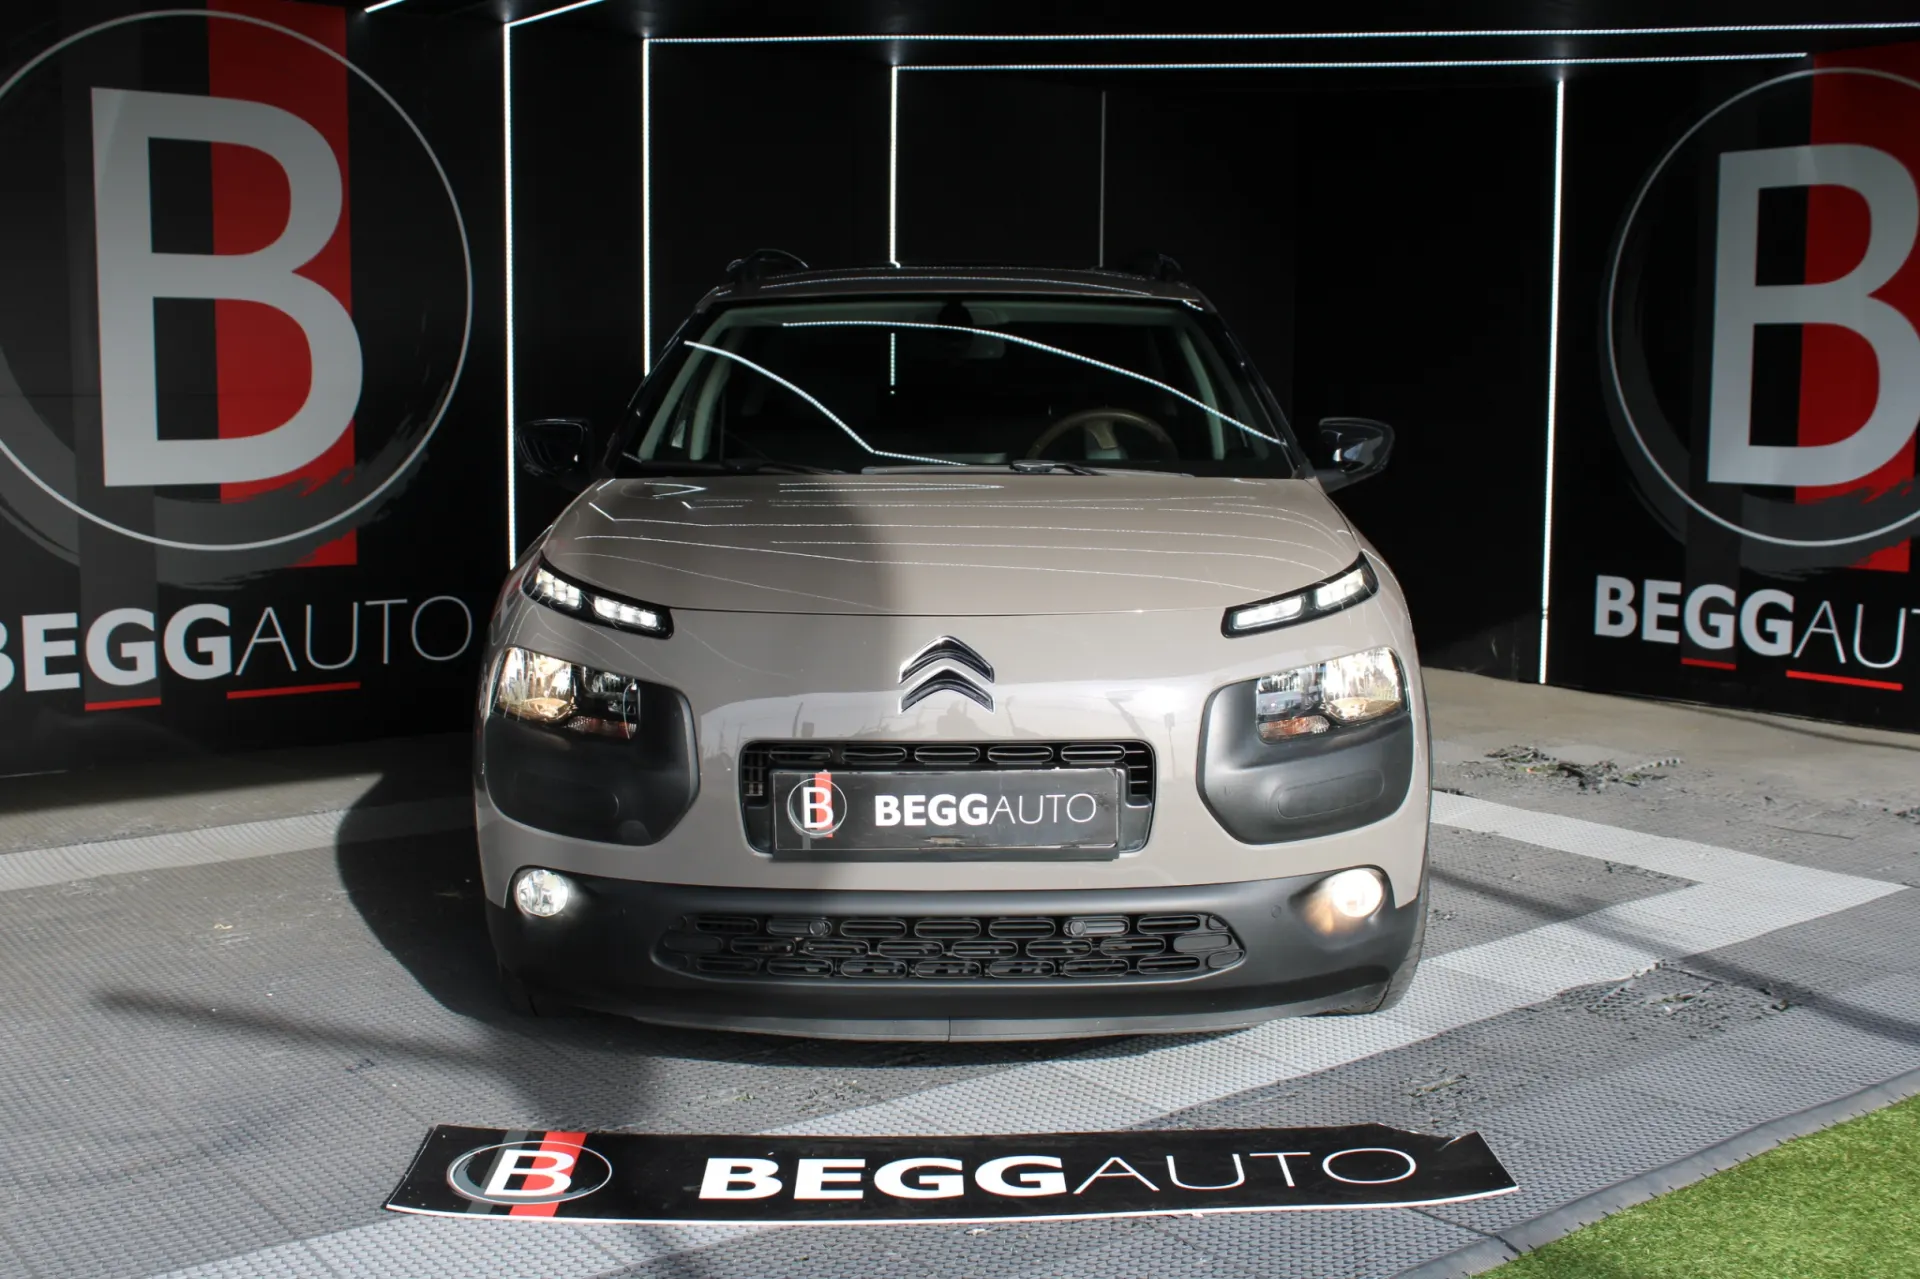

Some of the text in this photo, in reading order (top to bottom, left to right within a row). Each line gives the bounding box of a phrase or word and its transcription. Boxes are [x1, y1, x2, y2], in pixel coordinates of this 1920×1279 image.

[91, 87, 363, 487] B
[1707, 143, 1920, 487] B
[0, 595, 473, 692] EGGAUTO
[1594, 574, 1920, 669] BEGGAU
[803, 786, 834, 829] B
[874, 793, 1097, 827] BEGGAUTO
[484, 1148, 576, 1197] B
[698, 1147, 1417, 1200] BEGGAUTO
